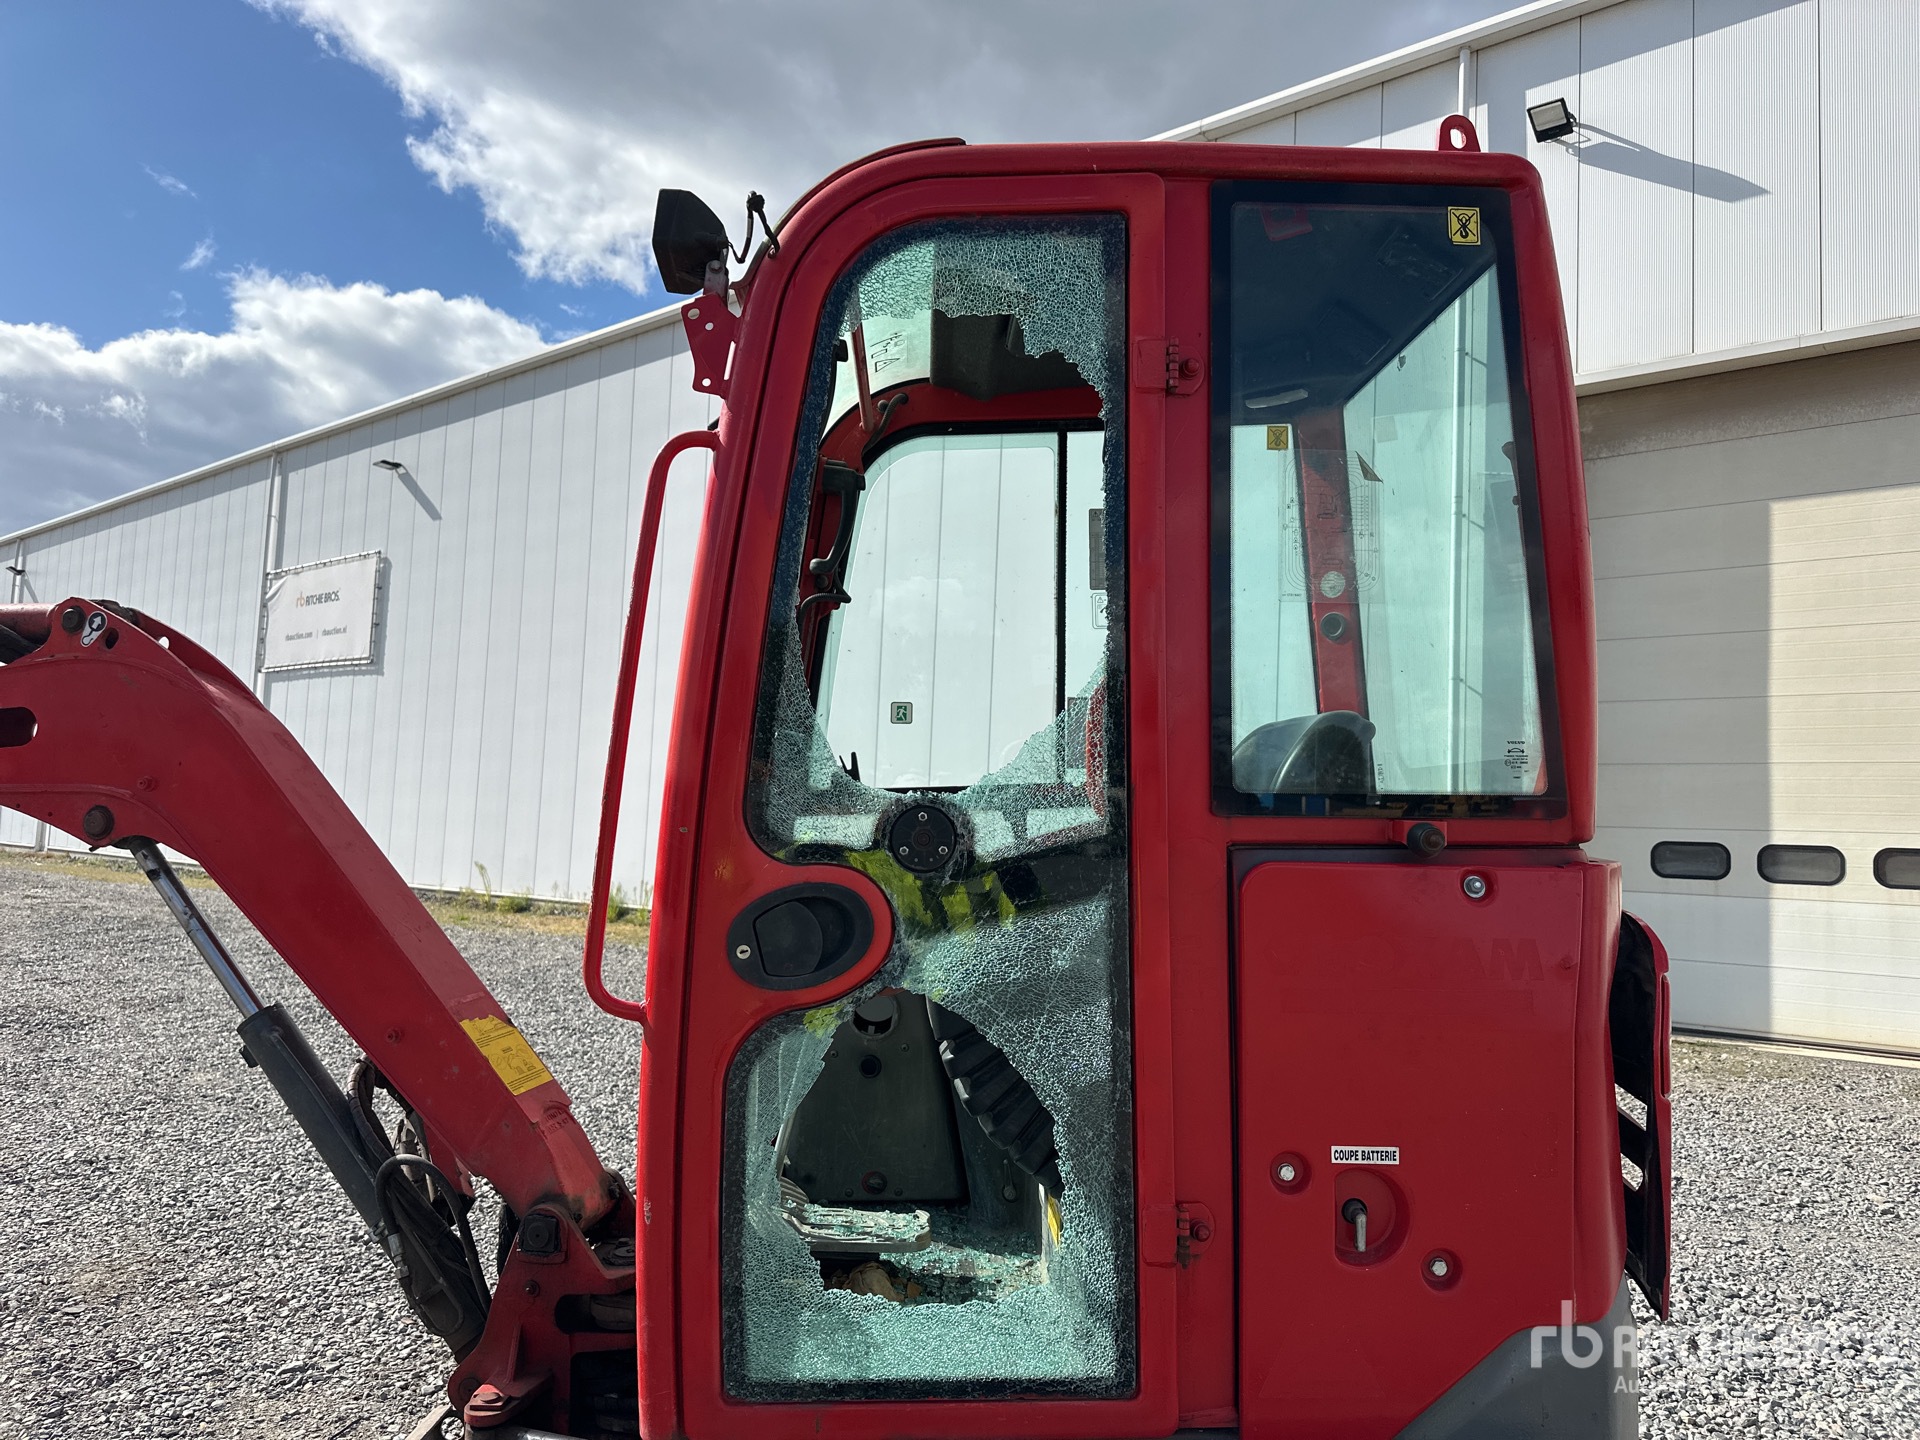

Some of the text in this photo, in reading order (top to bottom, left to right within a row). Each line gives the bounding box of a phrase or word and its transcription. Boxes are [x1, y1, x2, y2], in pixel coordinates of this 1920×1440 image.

[305, 593, 324, 607] RITCHIE
[285, 631, 313, 642] rbauction.com
[1333, 1149, 1397, 1162] COUPE BATTERIE
